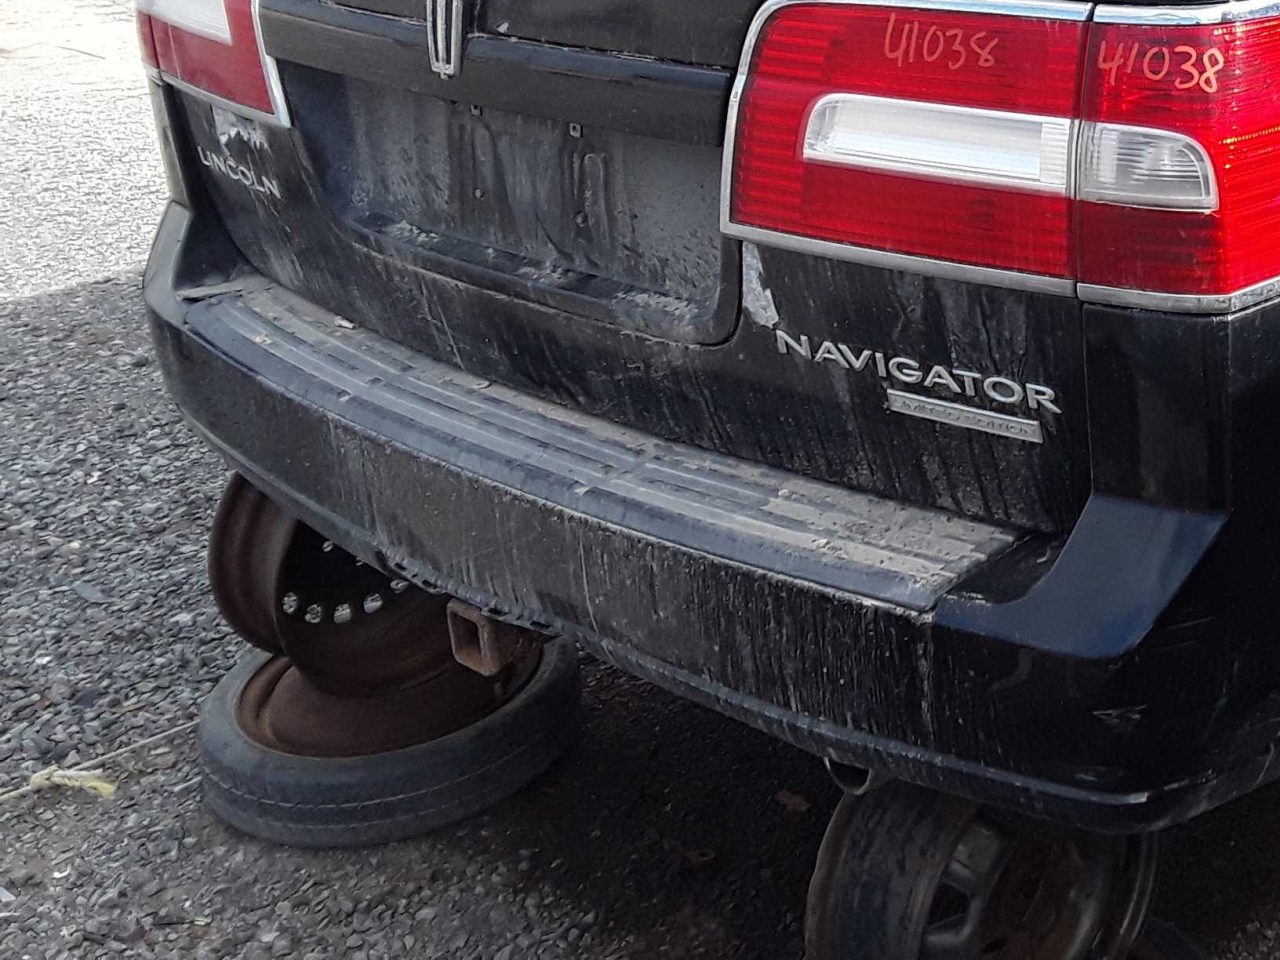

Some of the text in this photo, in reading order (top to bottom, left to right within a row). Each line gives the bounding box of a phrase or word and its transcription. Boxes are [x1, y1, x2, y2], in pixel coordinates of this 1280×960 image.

[883, 11, 998, 70] 41038
[1097, 40, 1226, 93] 41038
[197, 145, 283, 200] LINCOLN
[774, 328, 1063, 414] NAVIGATOR
